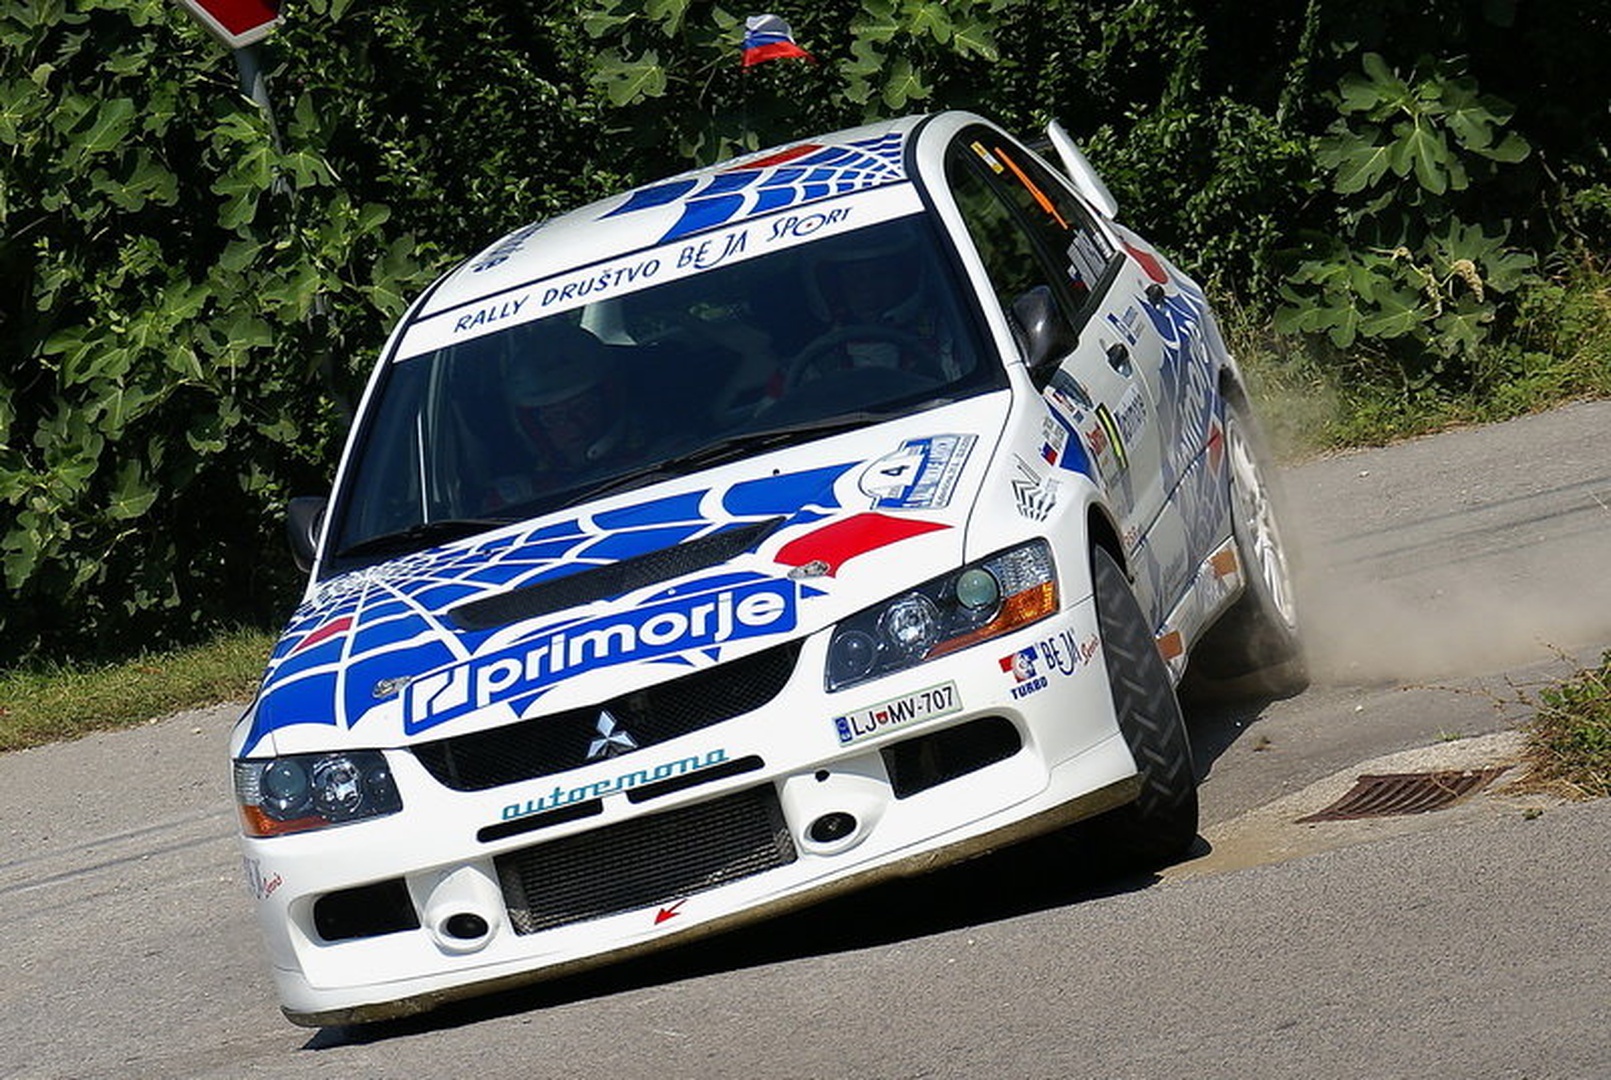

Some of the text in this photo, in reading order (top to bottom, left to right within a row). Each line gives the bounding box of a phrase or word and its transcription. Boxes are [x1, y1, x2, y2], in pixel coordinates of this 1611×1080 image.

[454, 294, 529, 333] RALLY
[541, 258, 660, 308] DRUŠTVO
[767, 207, 854, 243] SPORT
[477, 591, 786, 708] primorje
[1011, 676, 1048, 700] TURBO
[501, 748, 730, 820] autoemona
